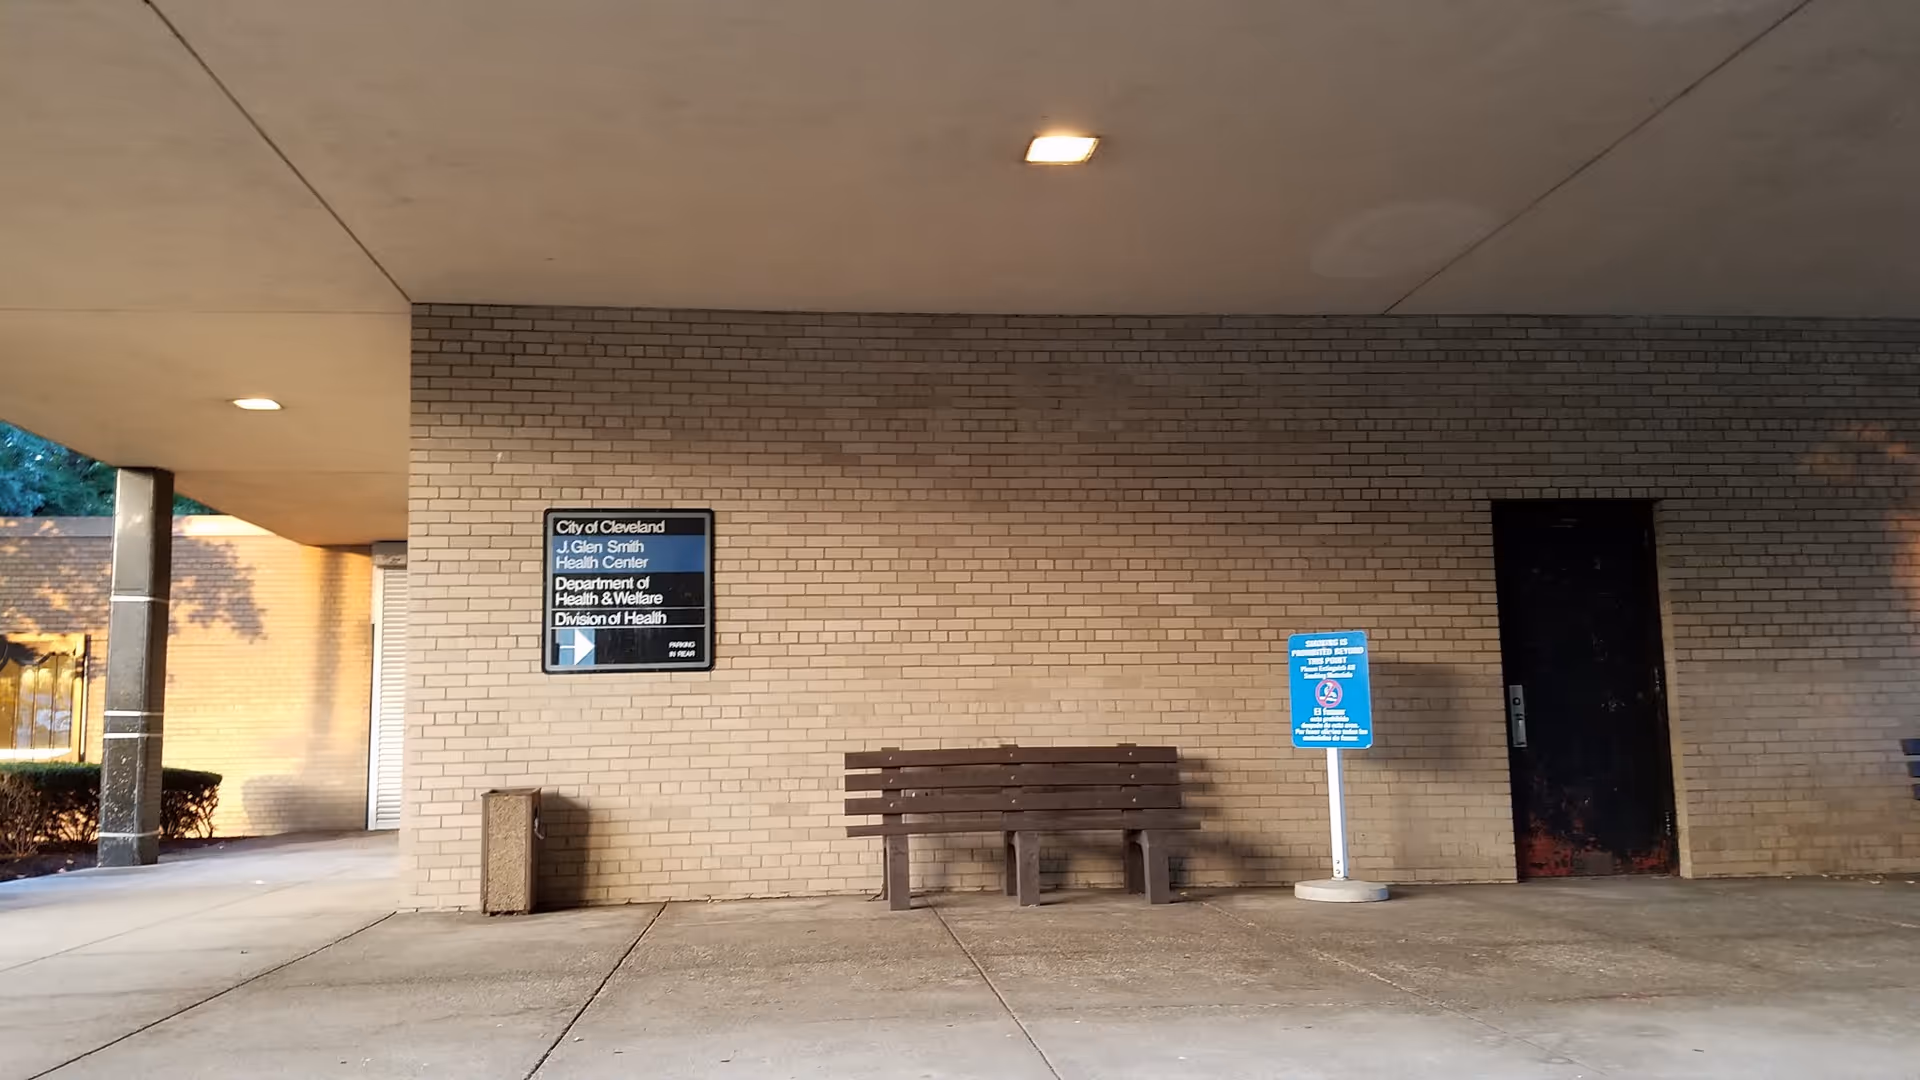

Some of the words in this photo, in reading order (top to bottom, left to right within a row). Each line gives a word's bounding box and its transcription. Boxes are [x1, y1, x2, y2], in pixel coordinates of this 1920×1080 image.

[556, 520, 585, 535] City
[585, 520, 598, 534] of
[600, 520, 665, 533] Cleveland
[570, 540, 603, 553] Glen
[607, 540, 644, 553] Smith
[556, 556, 598, 569] Health
[602, 556, 649, 569] Center
[555, 577, 634, 591] Department
[636, 576, 650, 590] of
[555, 592, 598, 606] Health
[601, 592, 613, 605] &
[613, 592, 663, 605] Welfare
[555, 612, 606, 626] Division
[608, 612, 622, 625] of
[624, 611, 667, 625] Health
